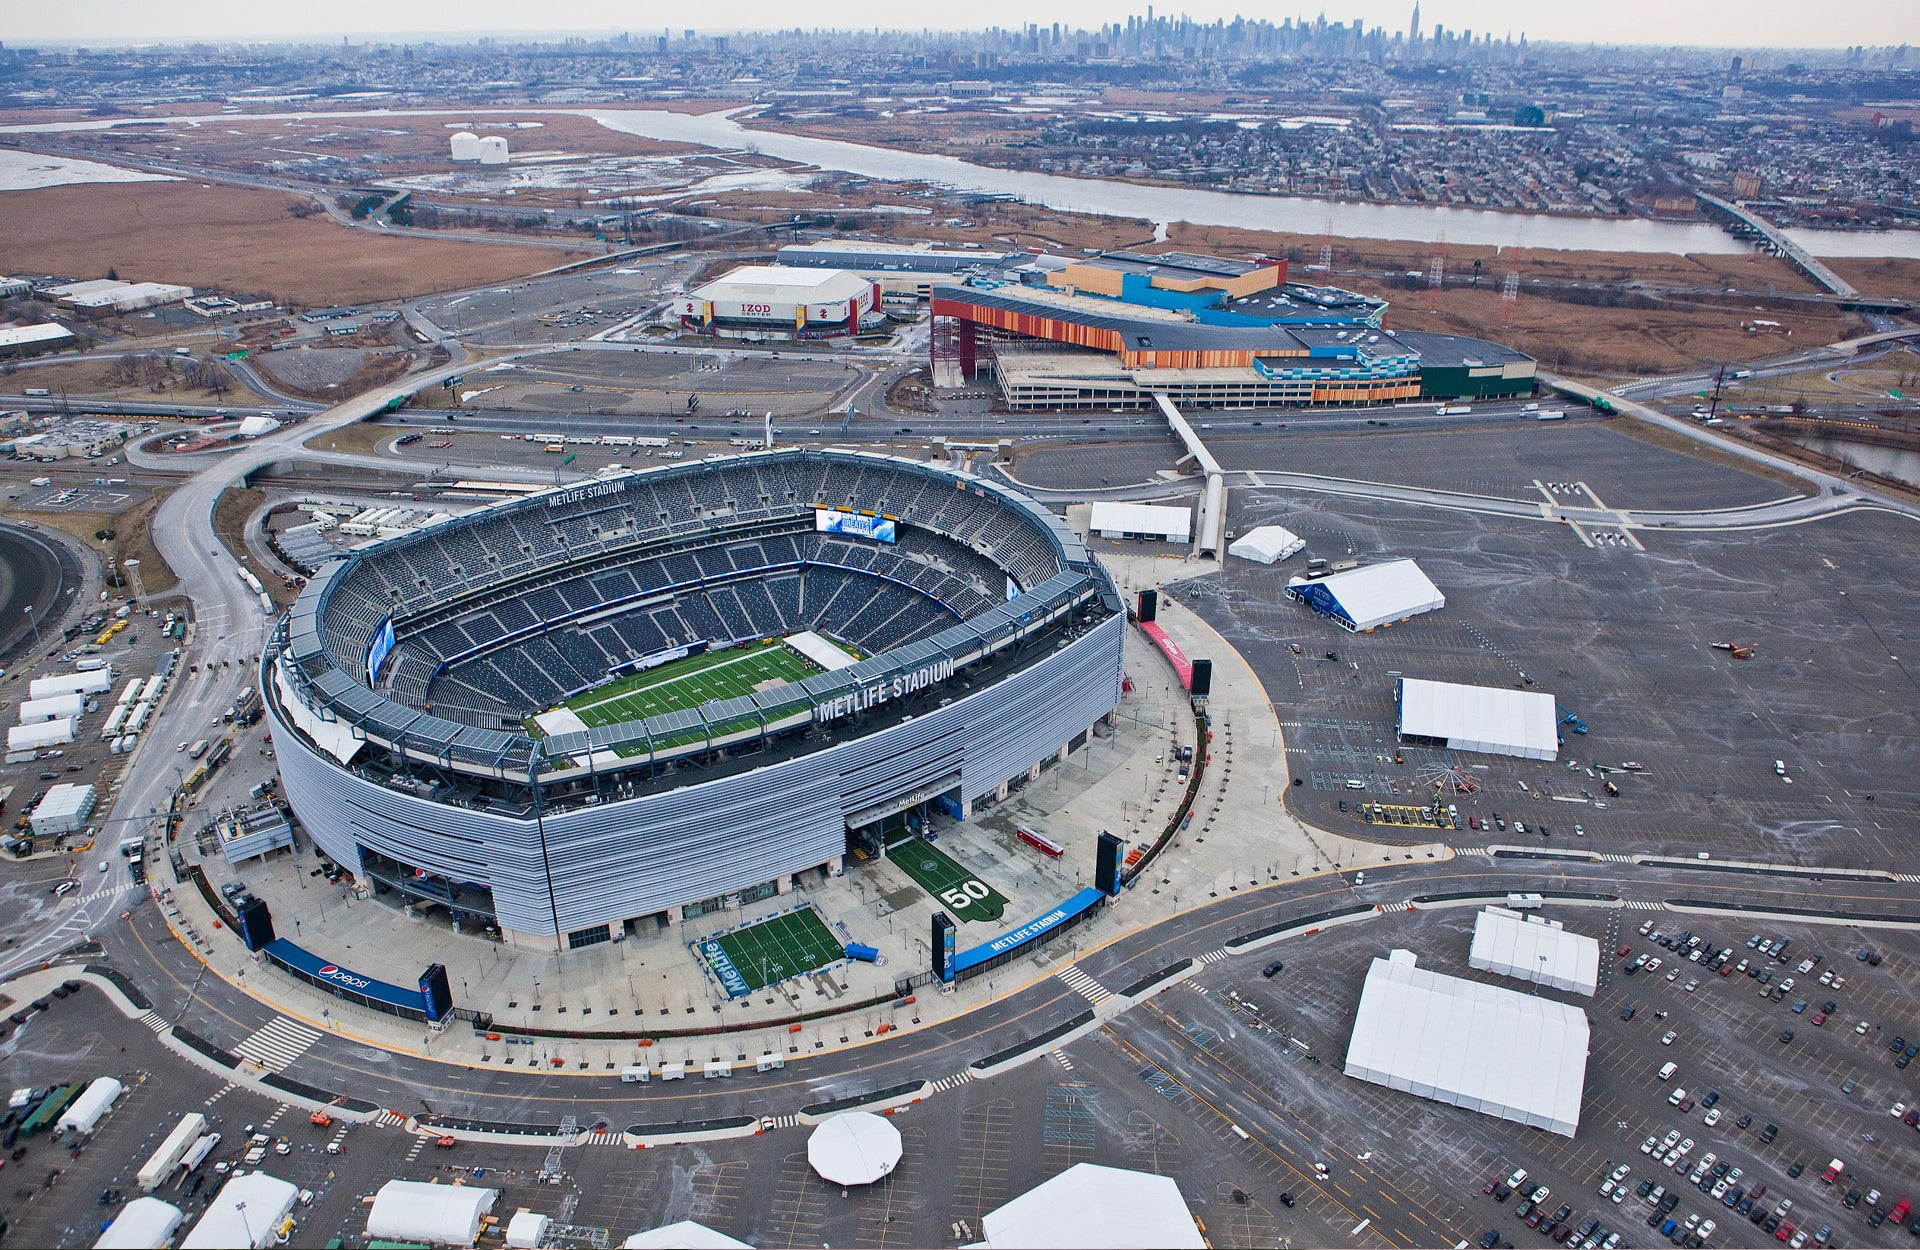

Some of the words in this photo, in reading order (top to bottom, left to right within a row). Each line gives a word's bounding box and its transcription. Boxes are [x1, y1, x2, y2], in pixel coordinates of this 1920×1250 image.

[741, 303, 771, 313] IZOD
[548, 489, 586, 508] METLIFE
[587, 481, 626, 499] STADIUM
[842, 518, 873, 531] GREATEST
[819, 682, 888, 723] METLIFE
[893, 658, 955, 698] STADIUM
[898, 792, 925, 807] MetLife
[940, 880, 989, 909] 50
[990, 928, 1033, 951] METLIFE
[1029, 909, 1067, 933] STADIUM
[705, 943, 747, 992] MetLife
[803, 953, 816, 962] 20
[330, 972, 371, 989] pepsi
